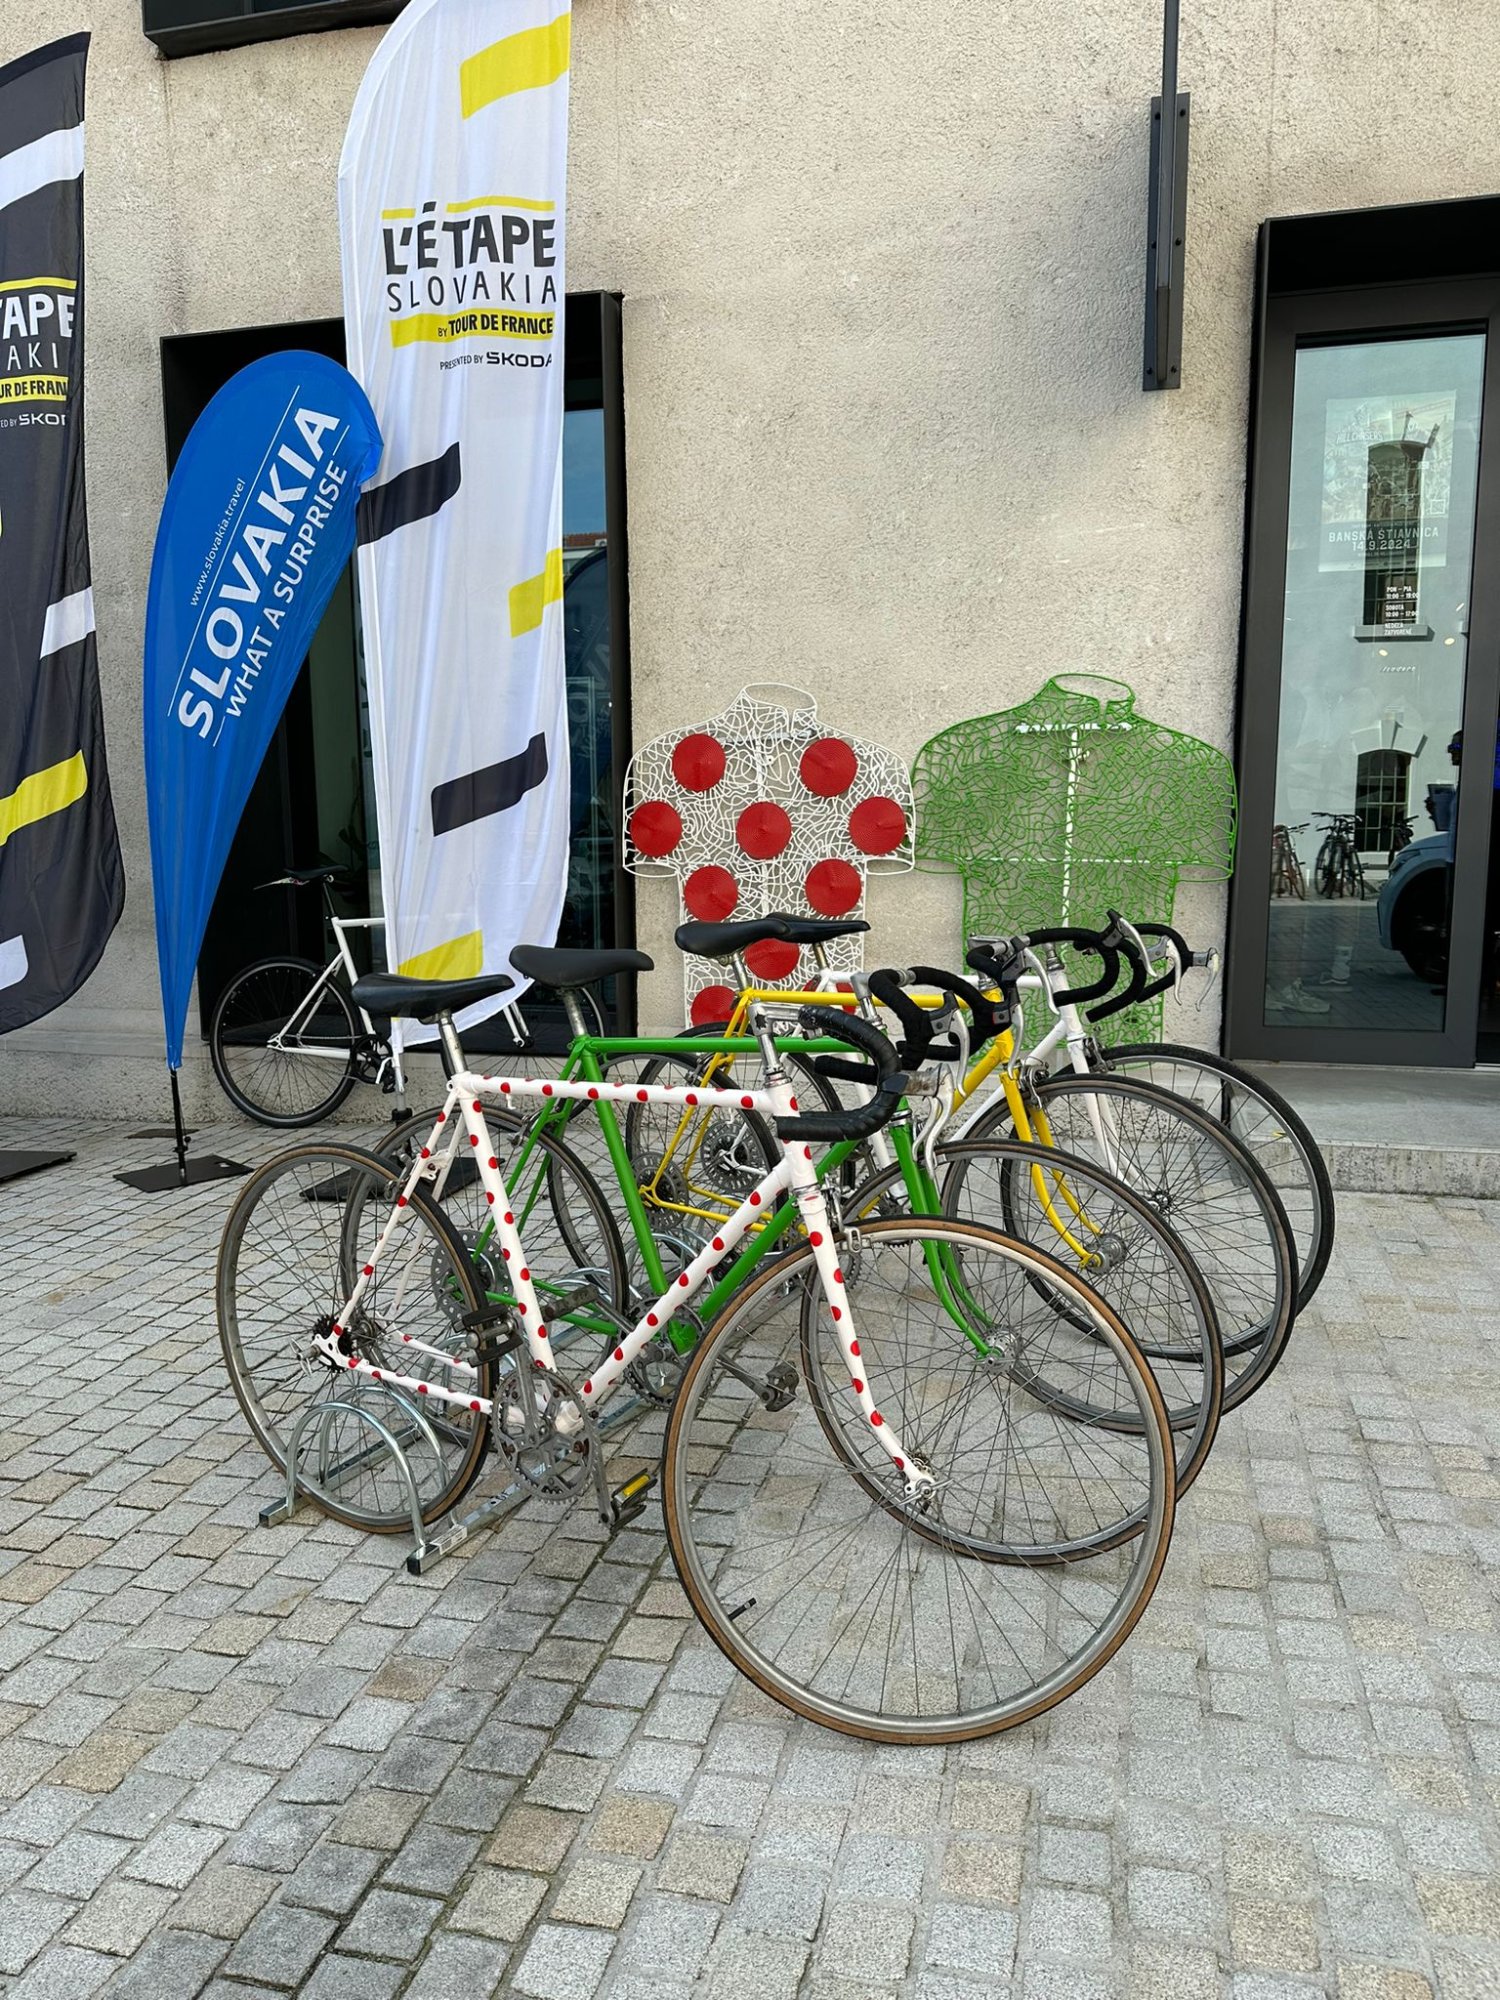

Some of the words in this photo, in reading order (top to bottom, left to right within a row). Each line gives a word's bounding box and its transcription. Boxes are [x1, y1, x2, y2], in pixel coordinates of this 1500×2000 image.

[382, 201, 556, 275] L'ÉTAPE
[387, 271, 557, 312] SLOVAKIA
[0, 293, 75, 340] APE
[438, 327, 448, 337] BY
[448, 314, 478, 336] TOUR
[481, 314, 499, 330] DE
[502, 315, 553, 335] FRANCE
[474, 355, 484, 364] BY
[14, 382, 28, 397] DE
[10, 418, 17, 427] BY
[190, 477, 246, 606] www.slovakia.travel
[273, 459, 348, 605] SURPRISE
[178, 407, 340, 739] SLOVAKIA
[263, 607, 286, 630] A
[226, 626, 273, 718] WHAT
